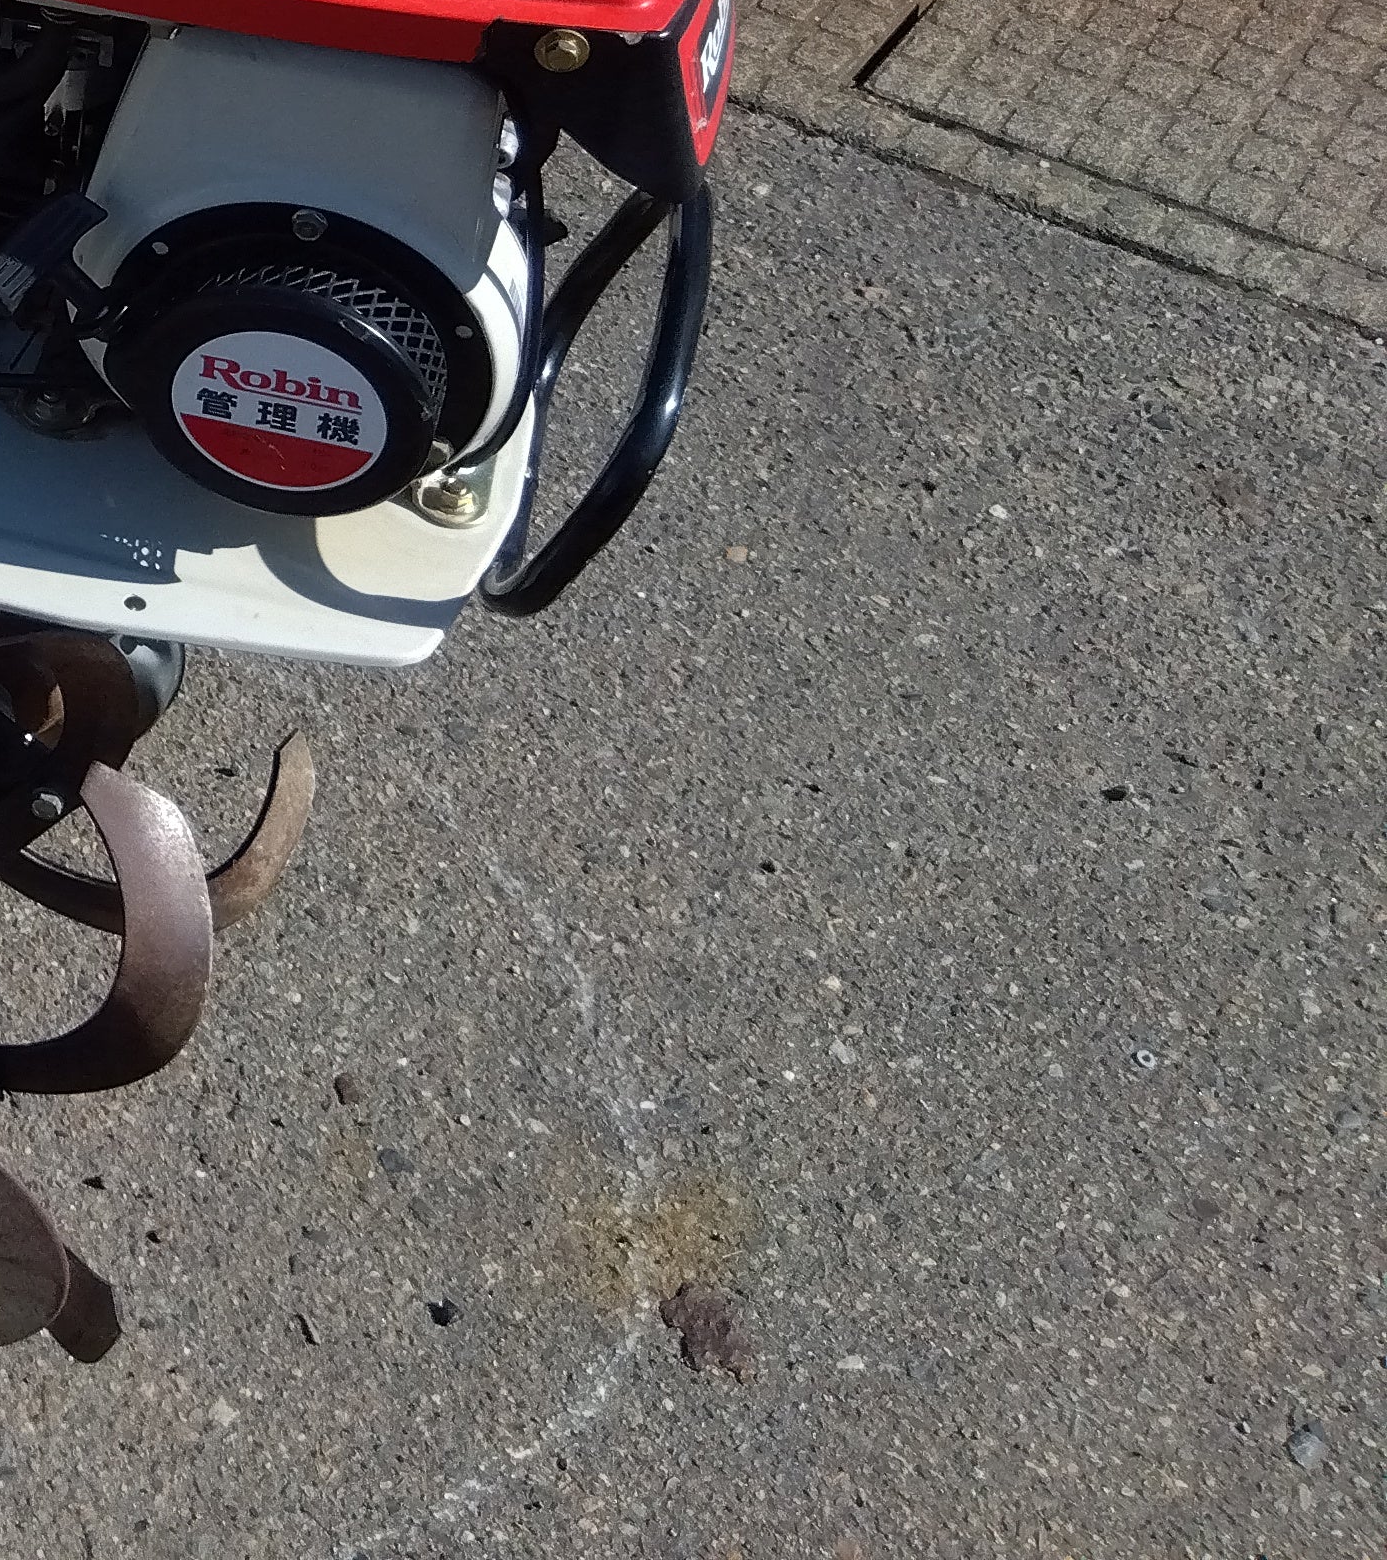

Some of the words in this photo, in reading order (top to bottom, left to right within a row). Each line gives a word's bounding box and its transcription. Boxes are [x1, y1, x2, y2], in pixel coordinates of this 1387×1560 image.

[199, 354, 363, 410] Robin
[196, 387, 361, 446] 管理機
